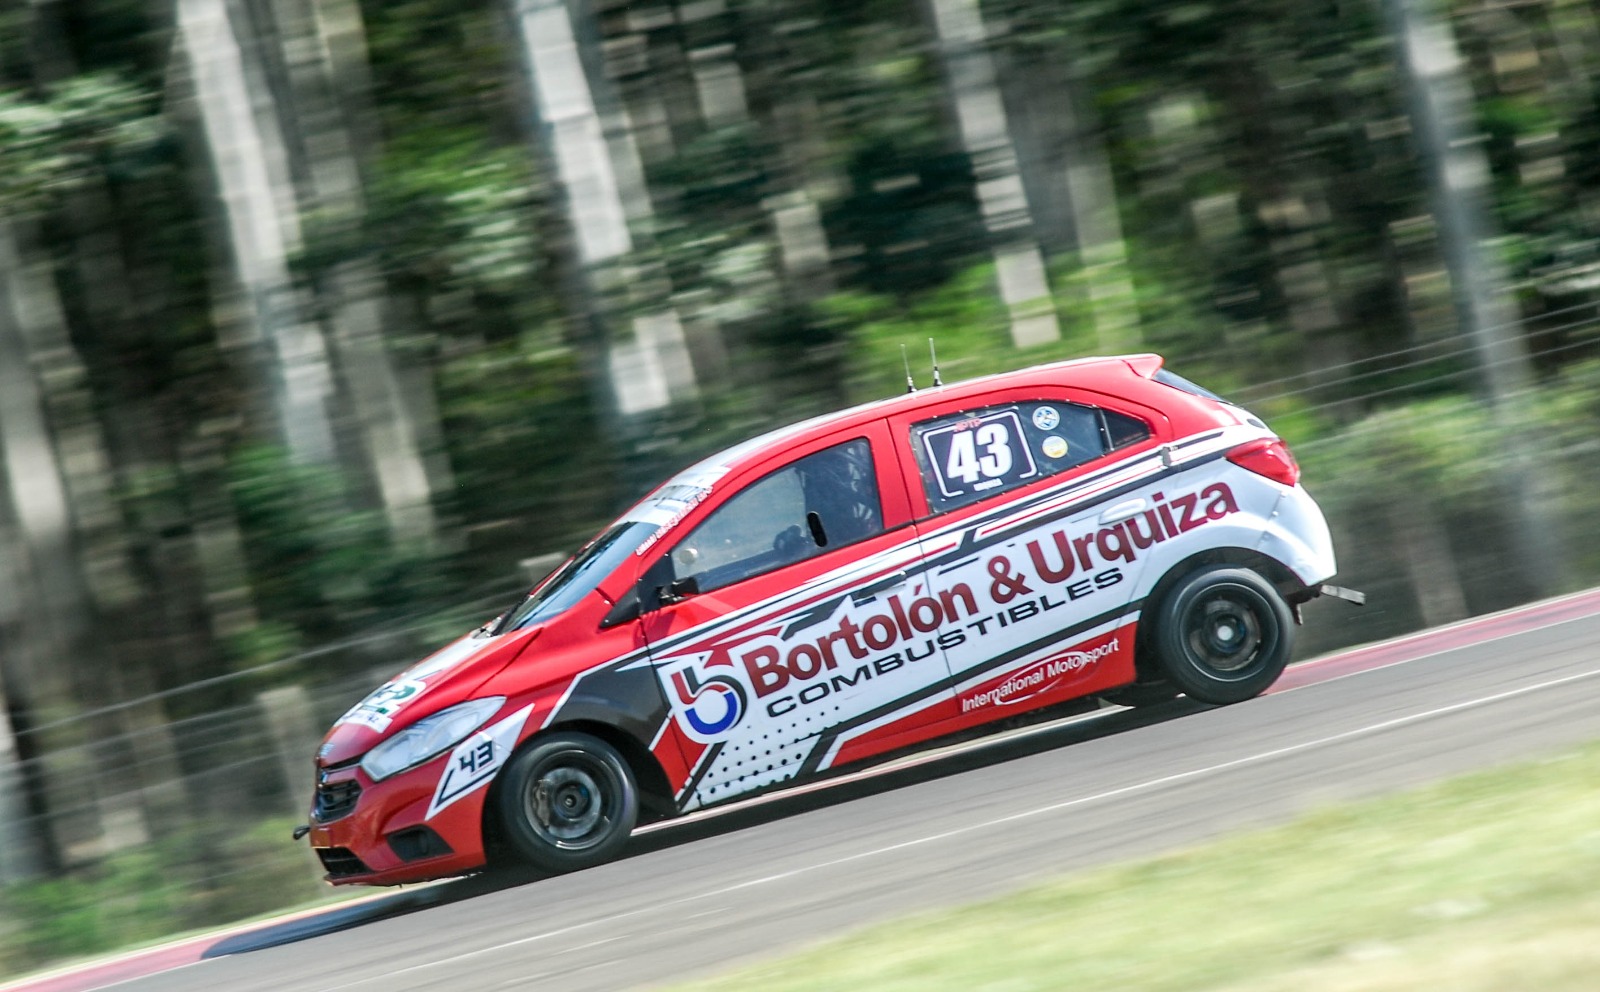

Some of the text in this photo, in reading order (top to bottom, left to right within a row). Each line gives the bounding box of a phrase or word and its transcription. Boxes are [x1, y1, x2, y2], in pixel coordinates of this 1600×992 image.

[946, 422, 1013, 484] 43
[741, 482, 1240, 699] Bortolón & Urquiza
[766, 567, 1124, 717] COMBUSTIBLES
[962, 637, 1119, 712] International Motosport
[458, 740, 495, 773] 43
